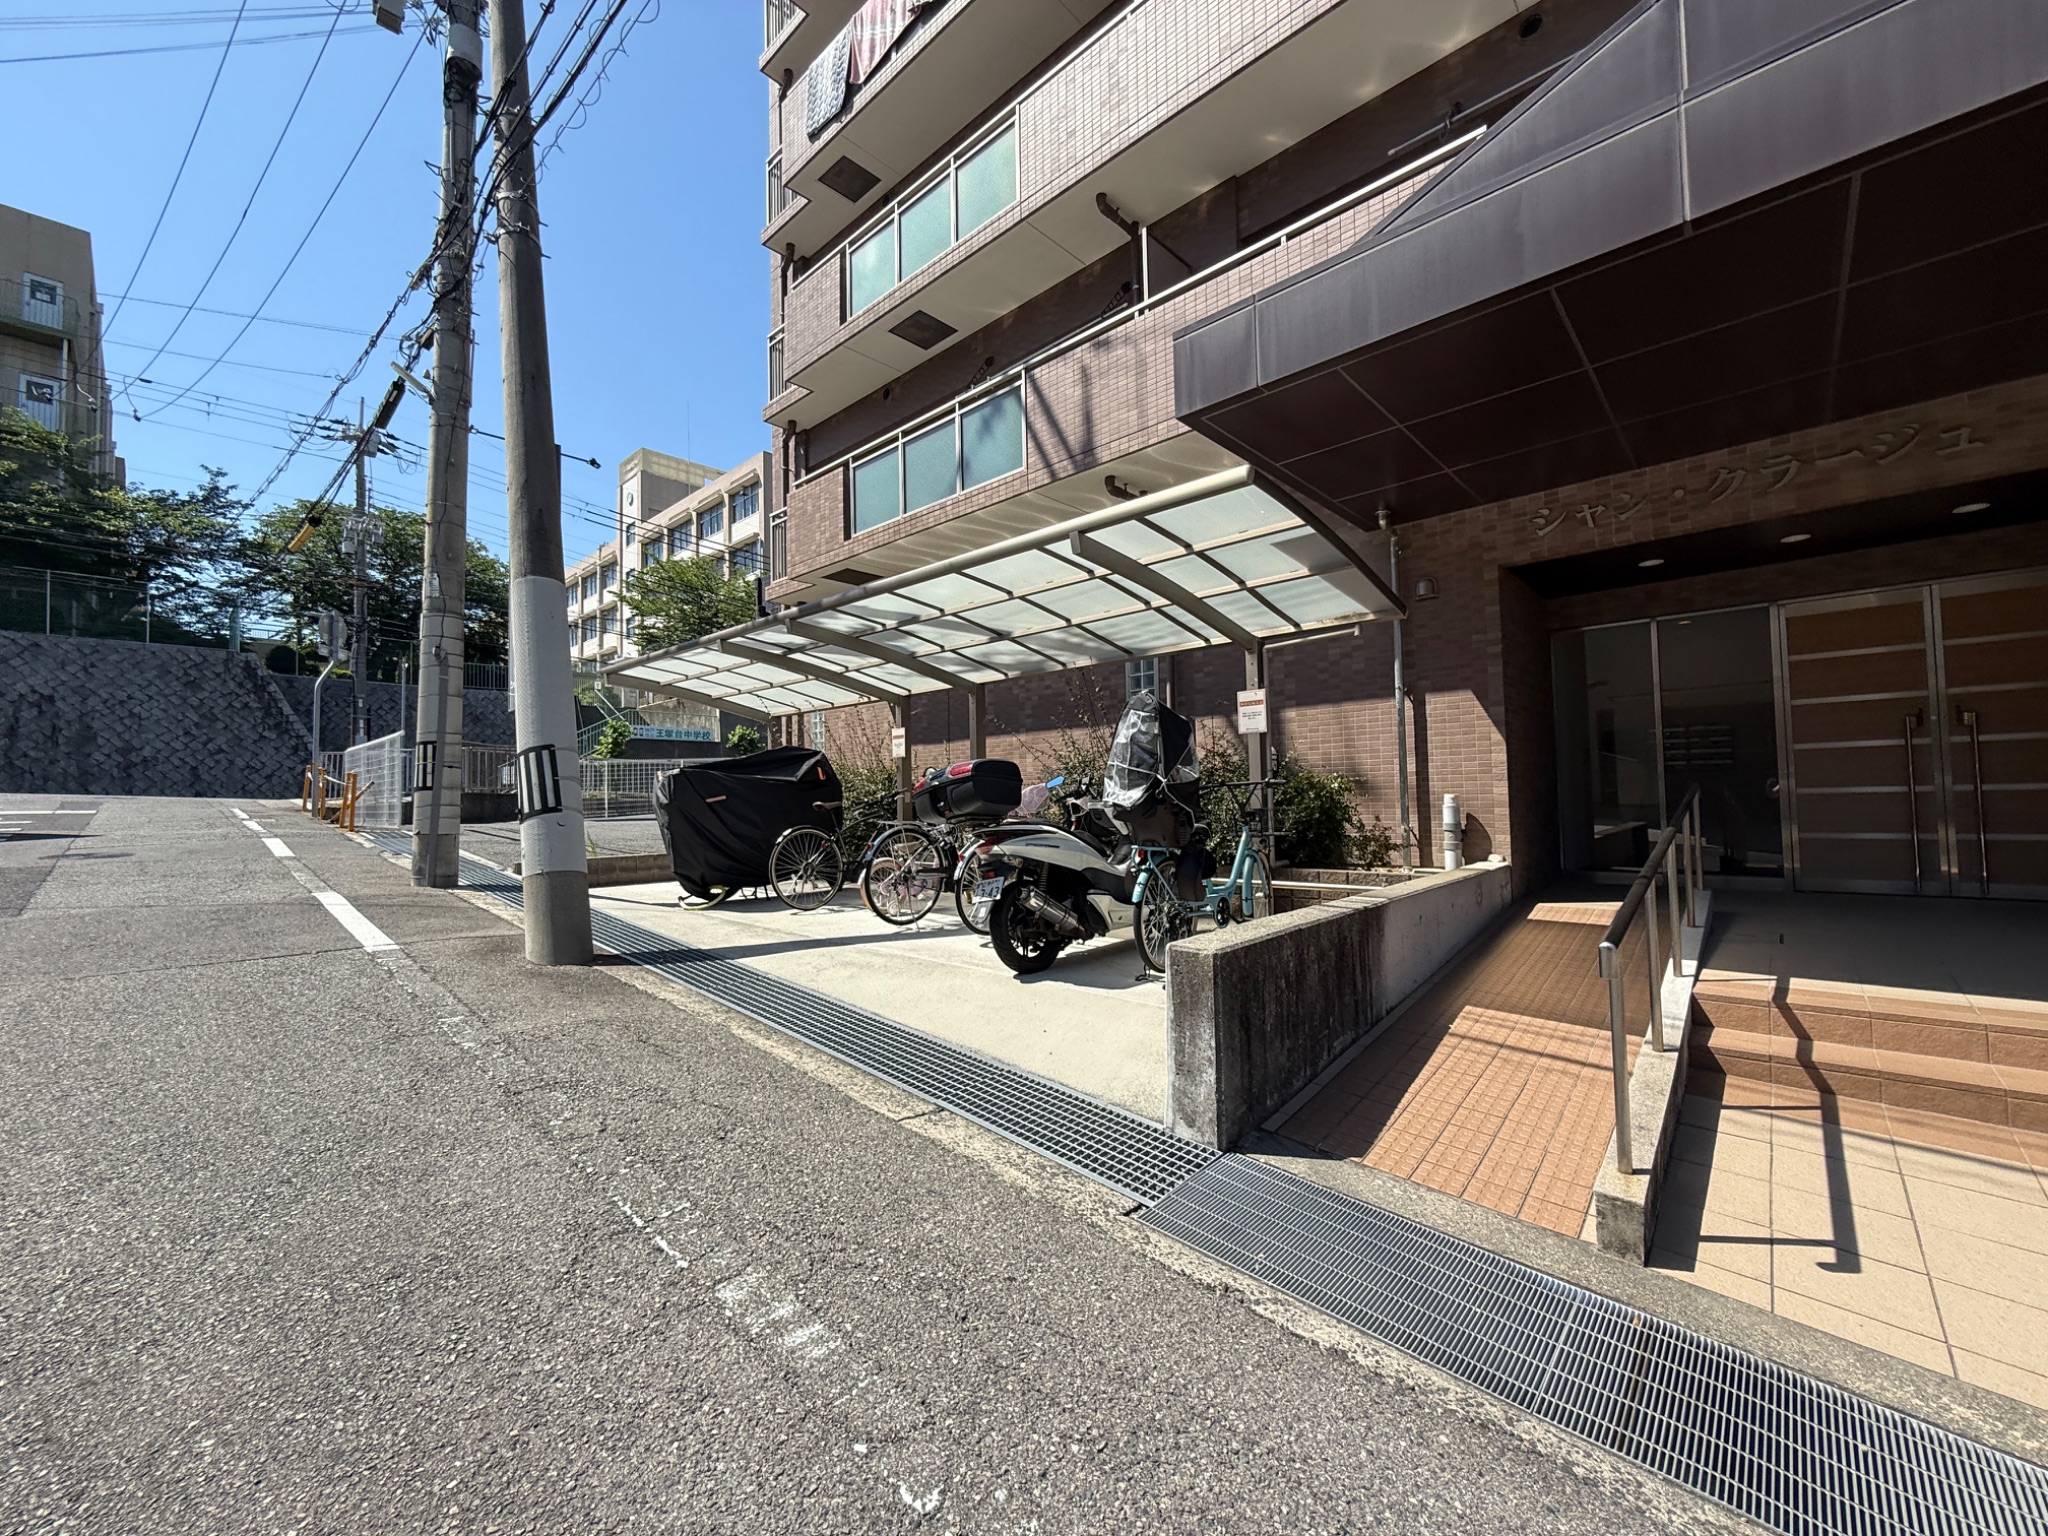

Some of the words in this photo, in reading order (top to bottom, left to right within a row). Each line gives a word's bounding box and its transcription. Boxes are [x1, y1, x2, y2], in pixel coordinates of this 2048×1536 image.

[1531, 423, 1985, 537] シャン・クラージュ
[656, 728, 711, 740] 王塚台中学校
